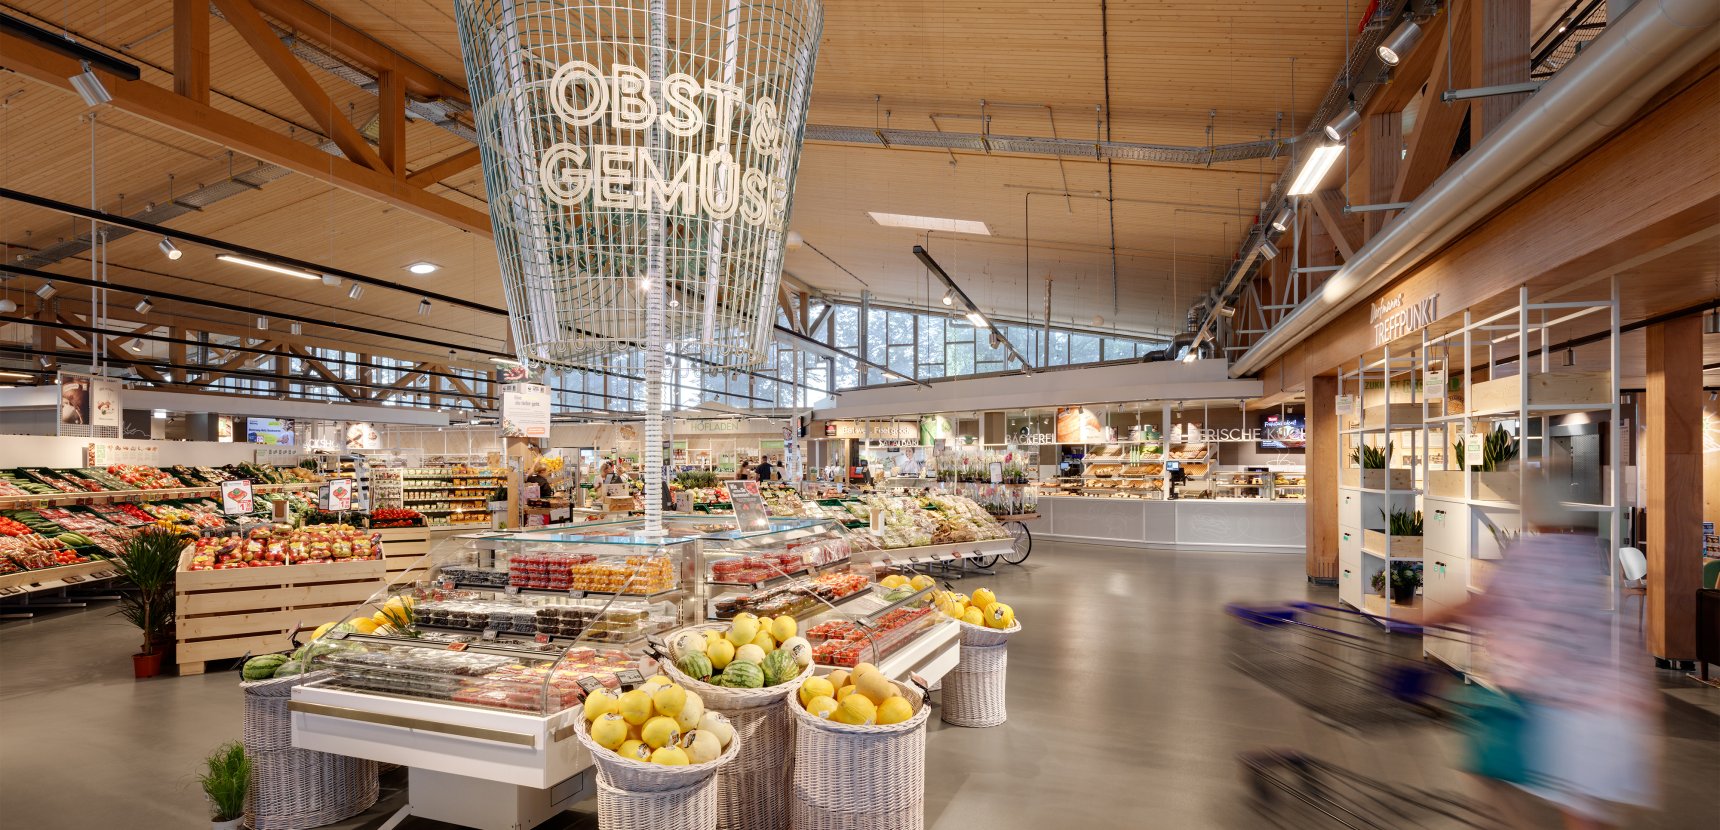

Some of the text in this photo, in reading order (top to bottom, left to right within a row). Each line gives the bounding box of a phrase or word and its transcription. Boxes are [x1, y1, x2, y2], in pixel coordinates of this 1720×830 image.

[550, 60, 782, 160] OBST &
[540, 142, 787, 232] GEMÜSE
[1374, 293, 1439, 346] TREFFPUNKT
[1006, 432, 1055, 445] BÄCKEREI
